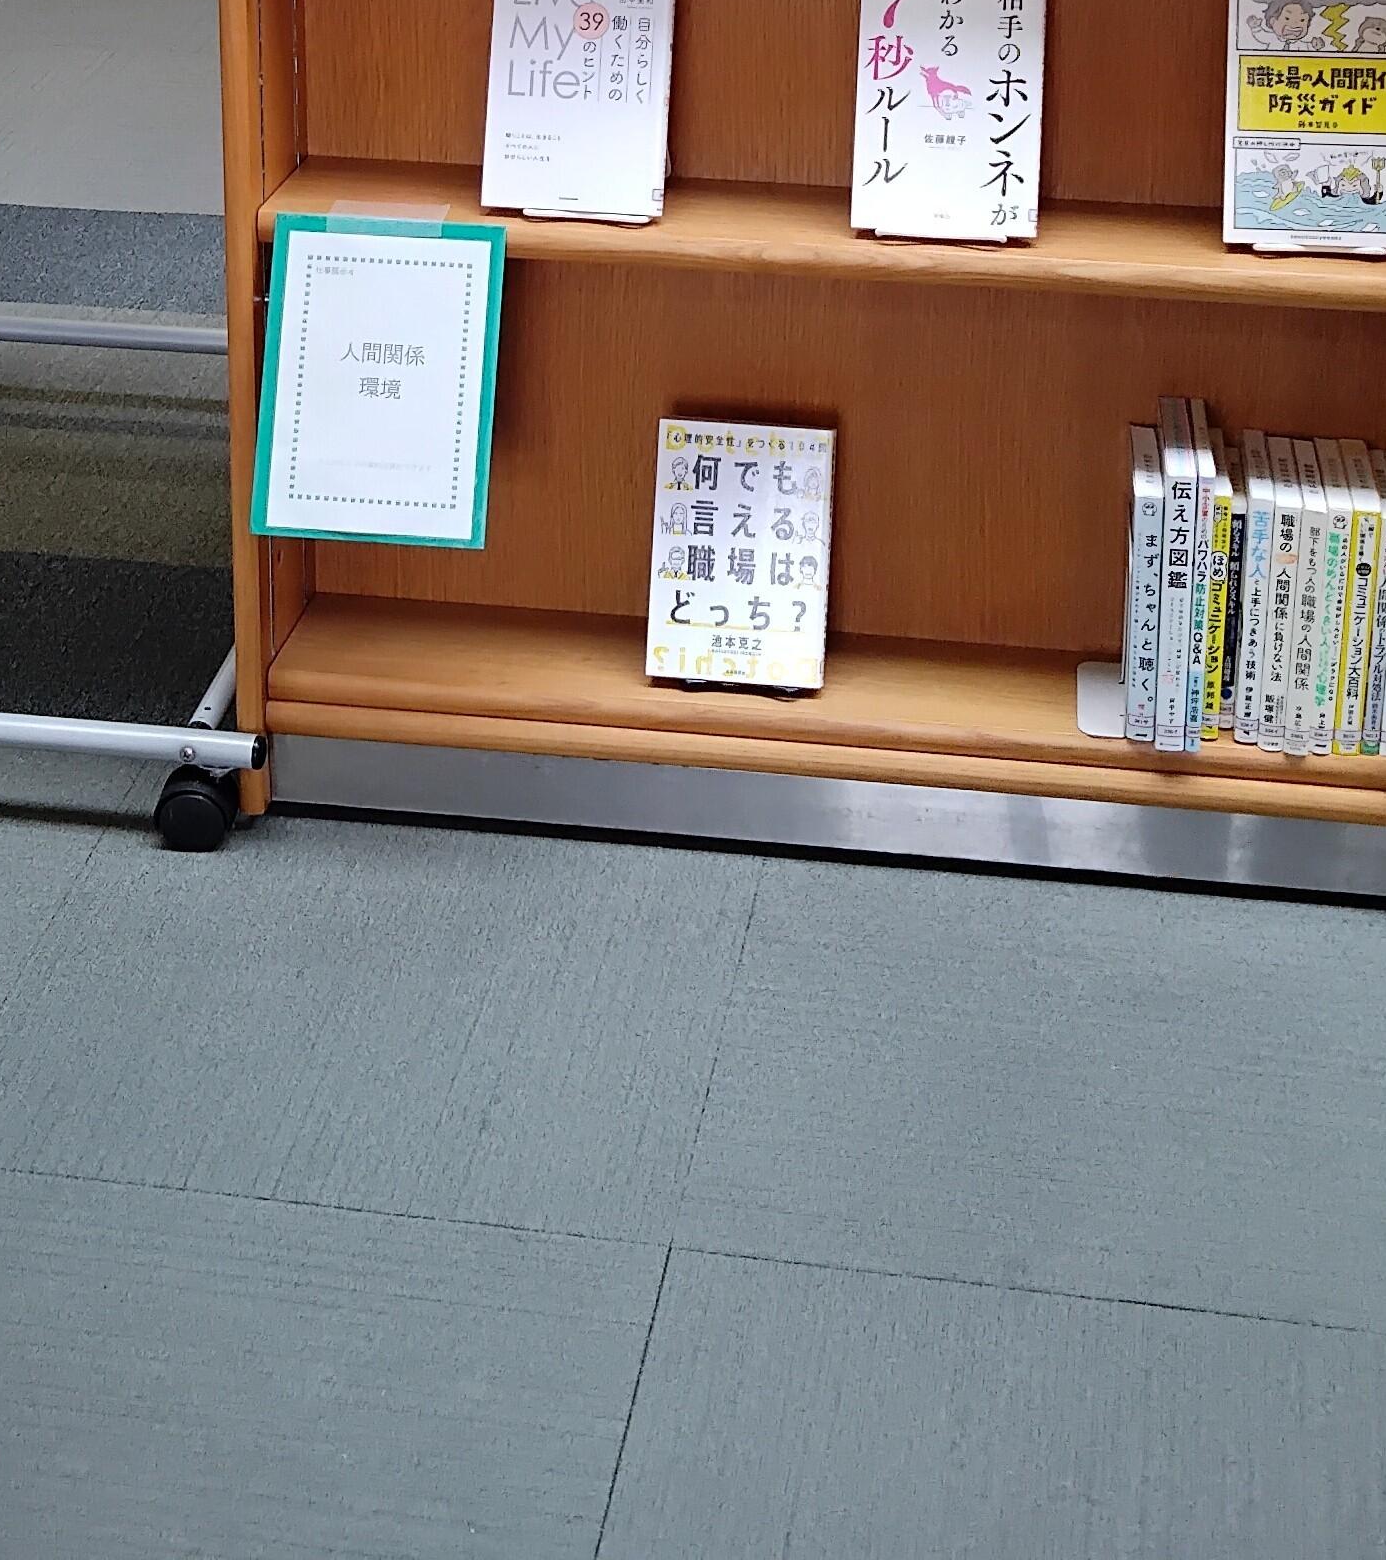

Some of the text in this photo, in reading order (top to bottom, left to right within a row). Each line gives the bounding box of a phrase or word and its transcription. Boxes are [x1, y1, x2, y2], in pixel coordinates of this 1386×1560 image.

[508, 11, 575, 61] My
[578, 11, 605, 101] 39 のヒント
[607, 14, 629, 102] 働くための
[634, 16, 653, 105] 自分らしく
[506, 59, 582, 100] Life
[1268, 93, 1379, 117] 防災ガイド
[339, 341, 427, 367] 人間関係
[358, 376, 402, 400] 環境
[691, 453, 799, 496] 何でも
[690, 499, 796, 541] 言える
[1167, 480, 1193, 589] 伝え方図鑑
[686, 544, 796, 588] 職場は
[668, 589, 808, 633] どっち?
[1138, 534, 1160, 703] まず、ちゃんと聴く。
[1244, 510, 1272, 681] 苦手な人と上手につきあう技術
[1270, 513, 1296, 683] 職場の 人間関係に負けない法
[1294, 526, 1321, 692] 部下をもつ人の職場の人間関係
[710, 634, 764, 652] 池本克之
[1346, 577, 1370, 701] コミュニケーション大百科
